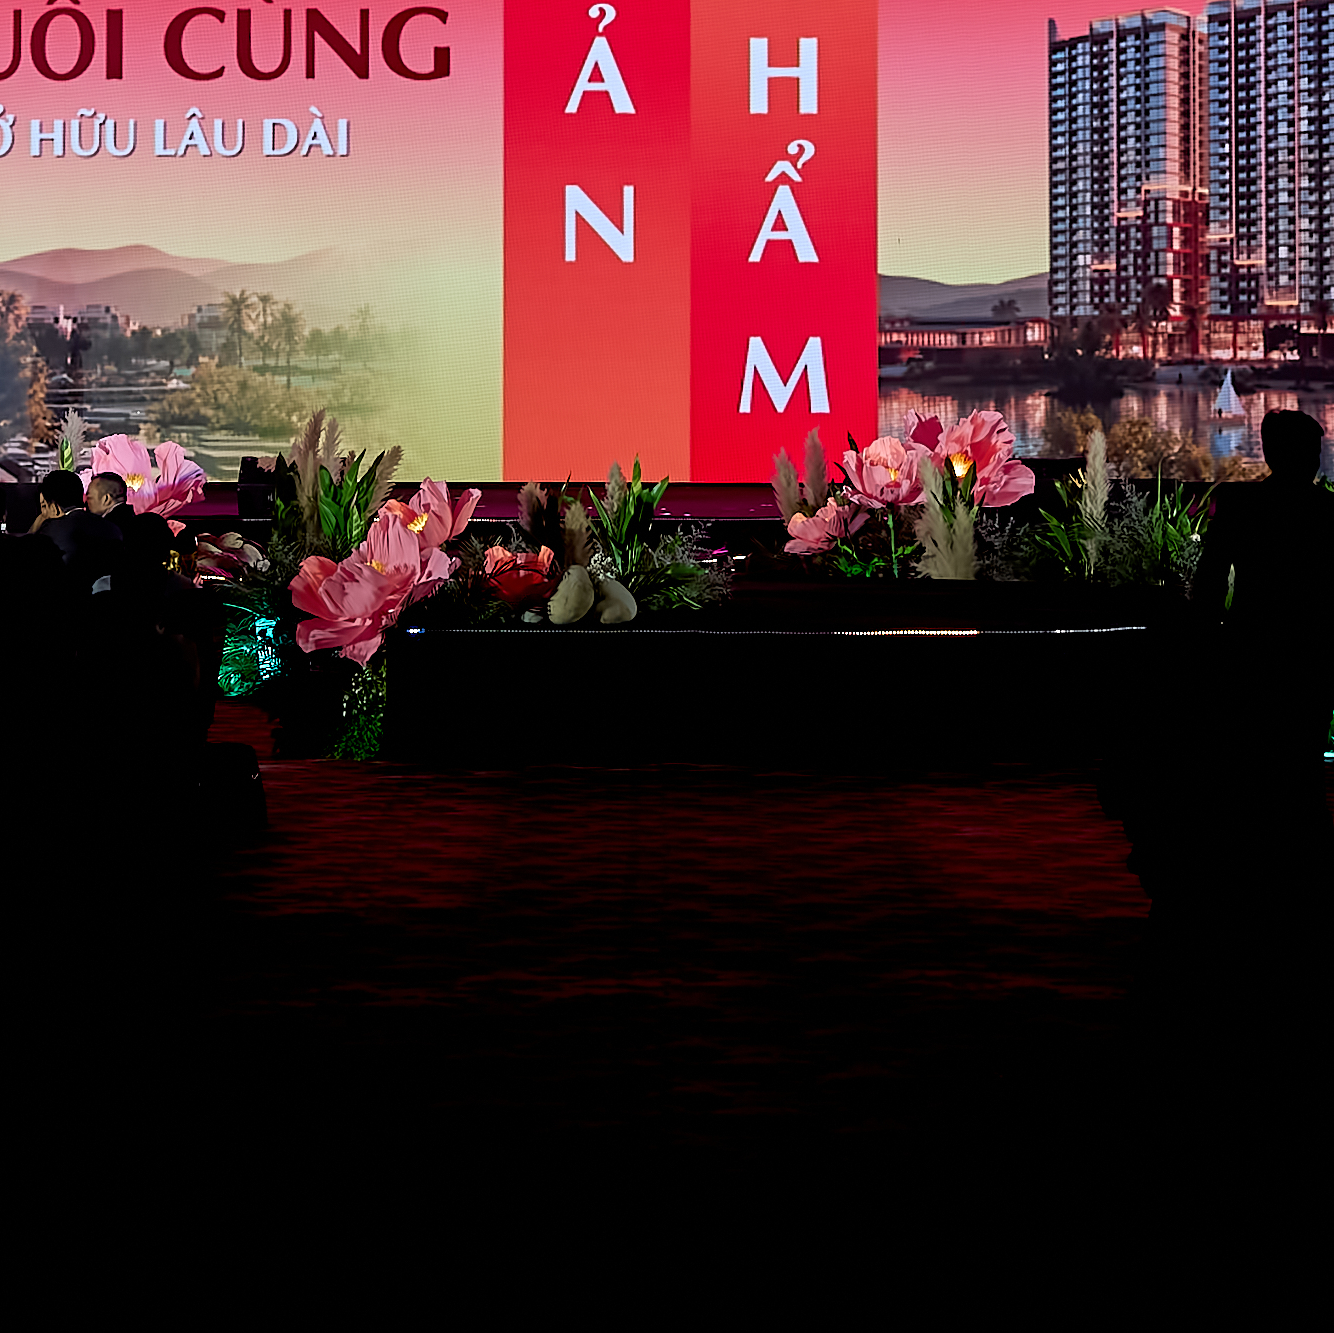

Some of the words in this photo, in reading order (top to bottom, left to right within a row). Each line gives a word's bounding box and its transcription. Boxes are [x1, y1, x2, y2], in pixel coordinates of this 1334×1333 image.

[30, 108, 134, 156] HỮU
[154, 108, 242, 155] LÂU
[263, 106, 347, 155] DÀI
